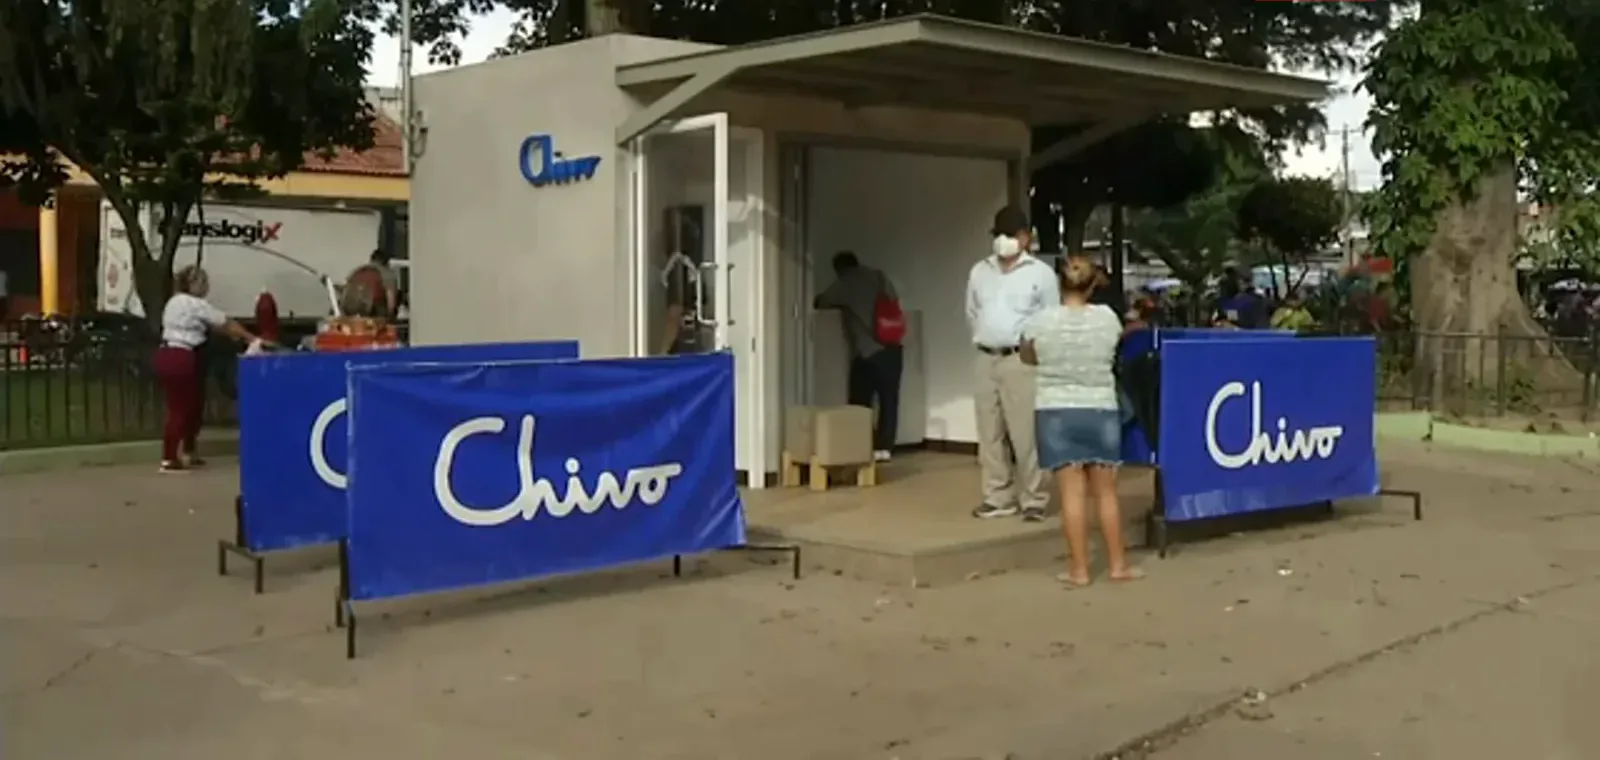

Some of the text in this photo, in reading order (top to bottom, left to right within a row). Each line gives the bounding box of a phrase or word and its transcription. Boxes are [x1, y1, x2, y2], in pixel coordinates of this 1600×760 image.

[158, 219, 283, 244] anslogix
[1205, 380, 1343, 469] Chivo
[434, 414, 682, 527] Chivo
